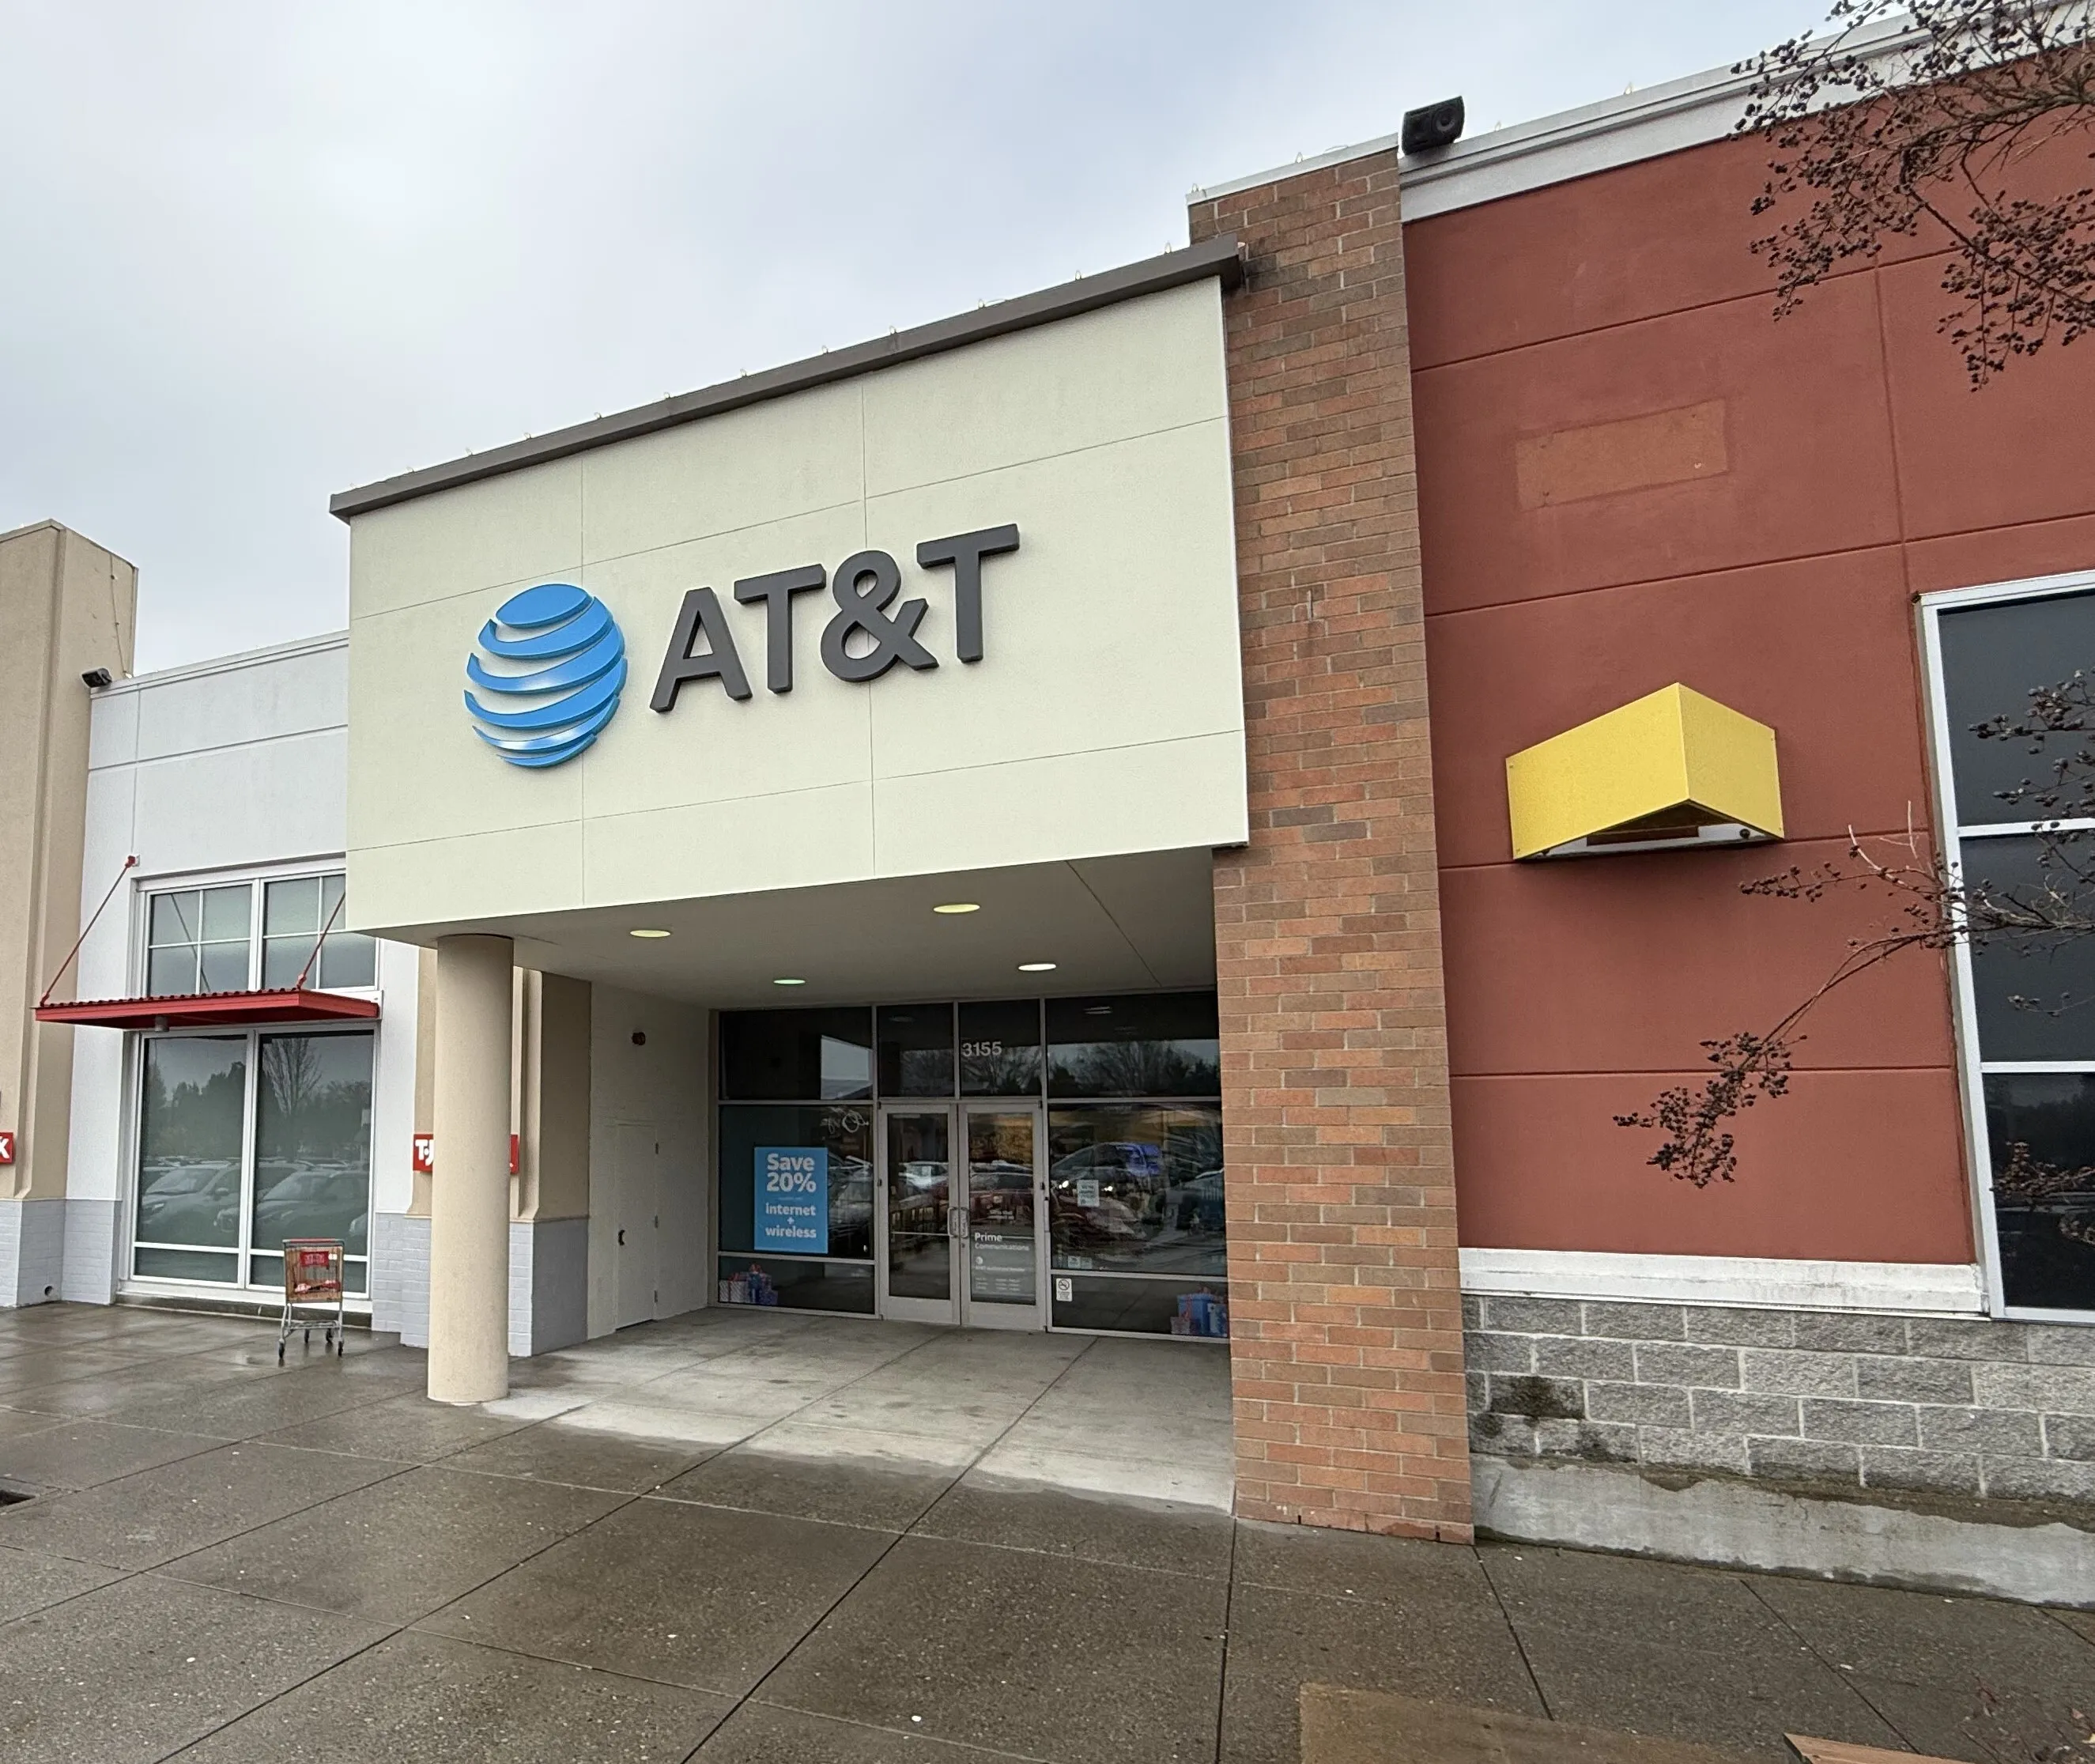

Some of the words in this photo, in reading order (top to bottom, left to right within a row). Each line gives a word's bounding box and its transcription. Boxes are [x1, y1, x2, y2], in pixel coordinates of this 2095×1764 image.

[650, 523, 1021, 713] AT&T
[962, 1041, 1002, 1057] 3155
[767, 1153, 815, 1171] Save
[766, 1172, 817, 1192] 20%
[765, 1202, 816, 1216] internet
[765, 1224, 817, 1238] wireless
[974, 1232, 1003, 1242] Prime
